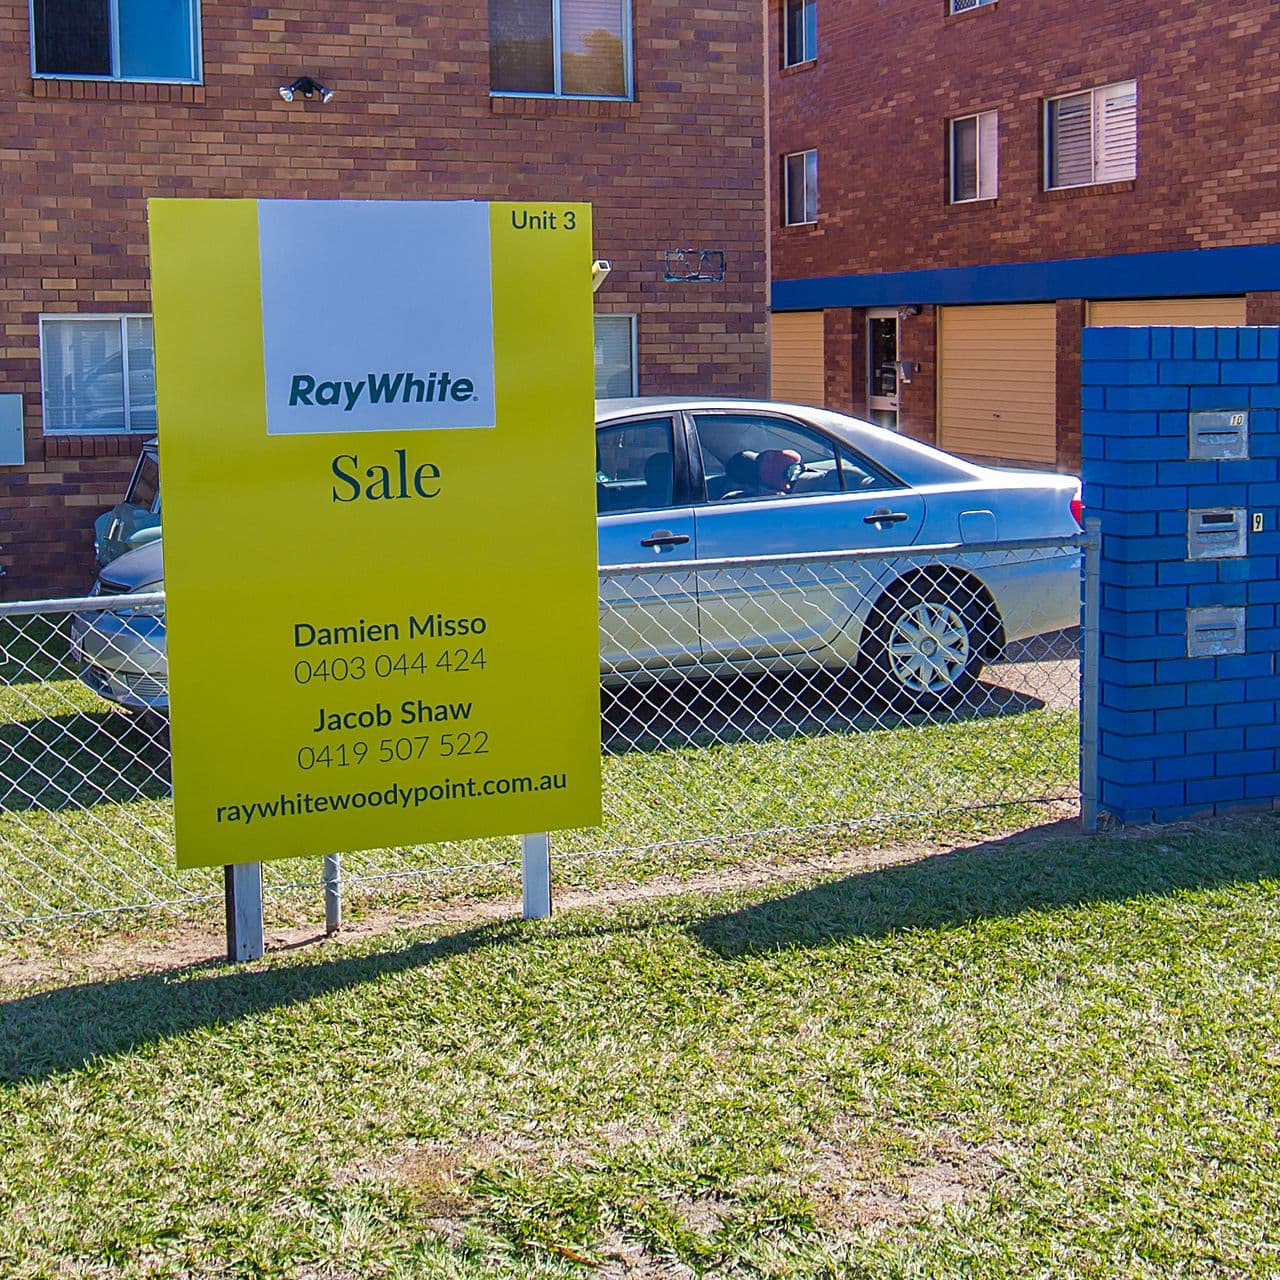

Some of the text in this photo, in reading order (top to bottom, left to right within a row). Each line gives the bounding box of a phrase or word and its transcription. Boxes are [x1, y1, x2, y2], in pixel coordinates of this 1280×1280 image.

[511, 210, 576, 231] Unit 3
[332, 449, 441, 503] Sale
[294, 613, 487, 648] Damien Misso
[294, 647, 488, 685] 0403 044 424
[313, 699, 472, 733] Jacob Shaw
[297, 730, 489, 770] 0419 507 522
[217, 772, 567, 824] raywhitewoodypoint.com.au
